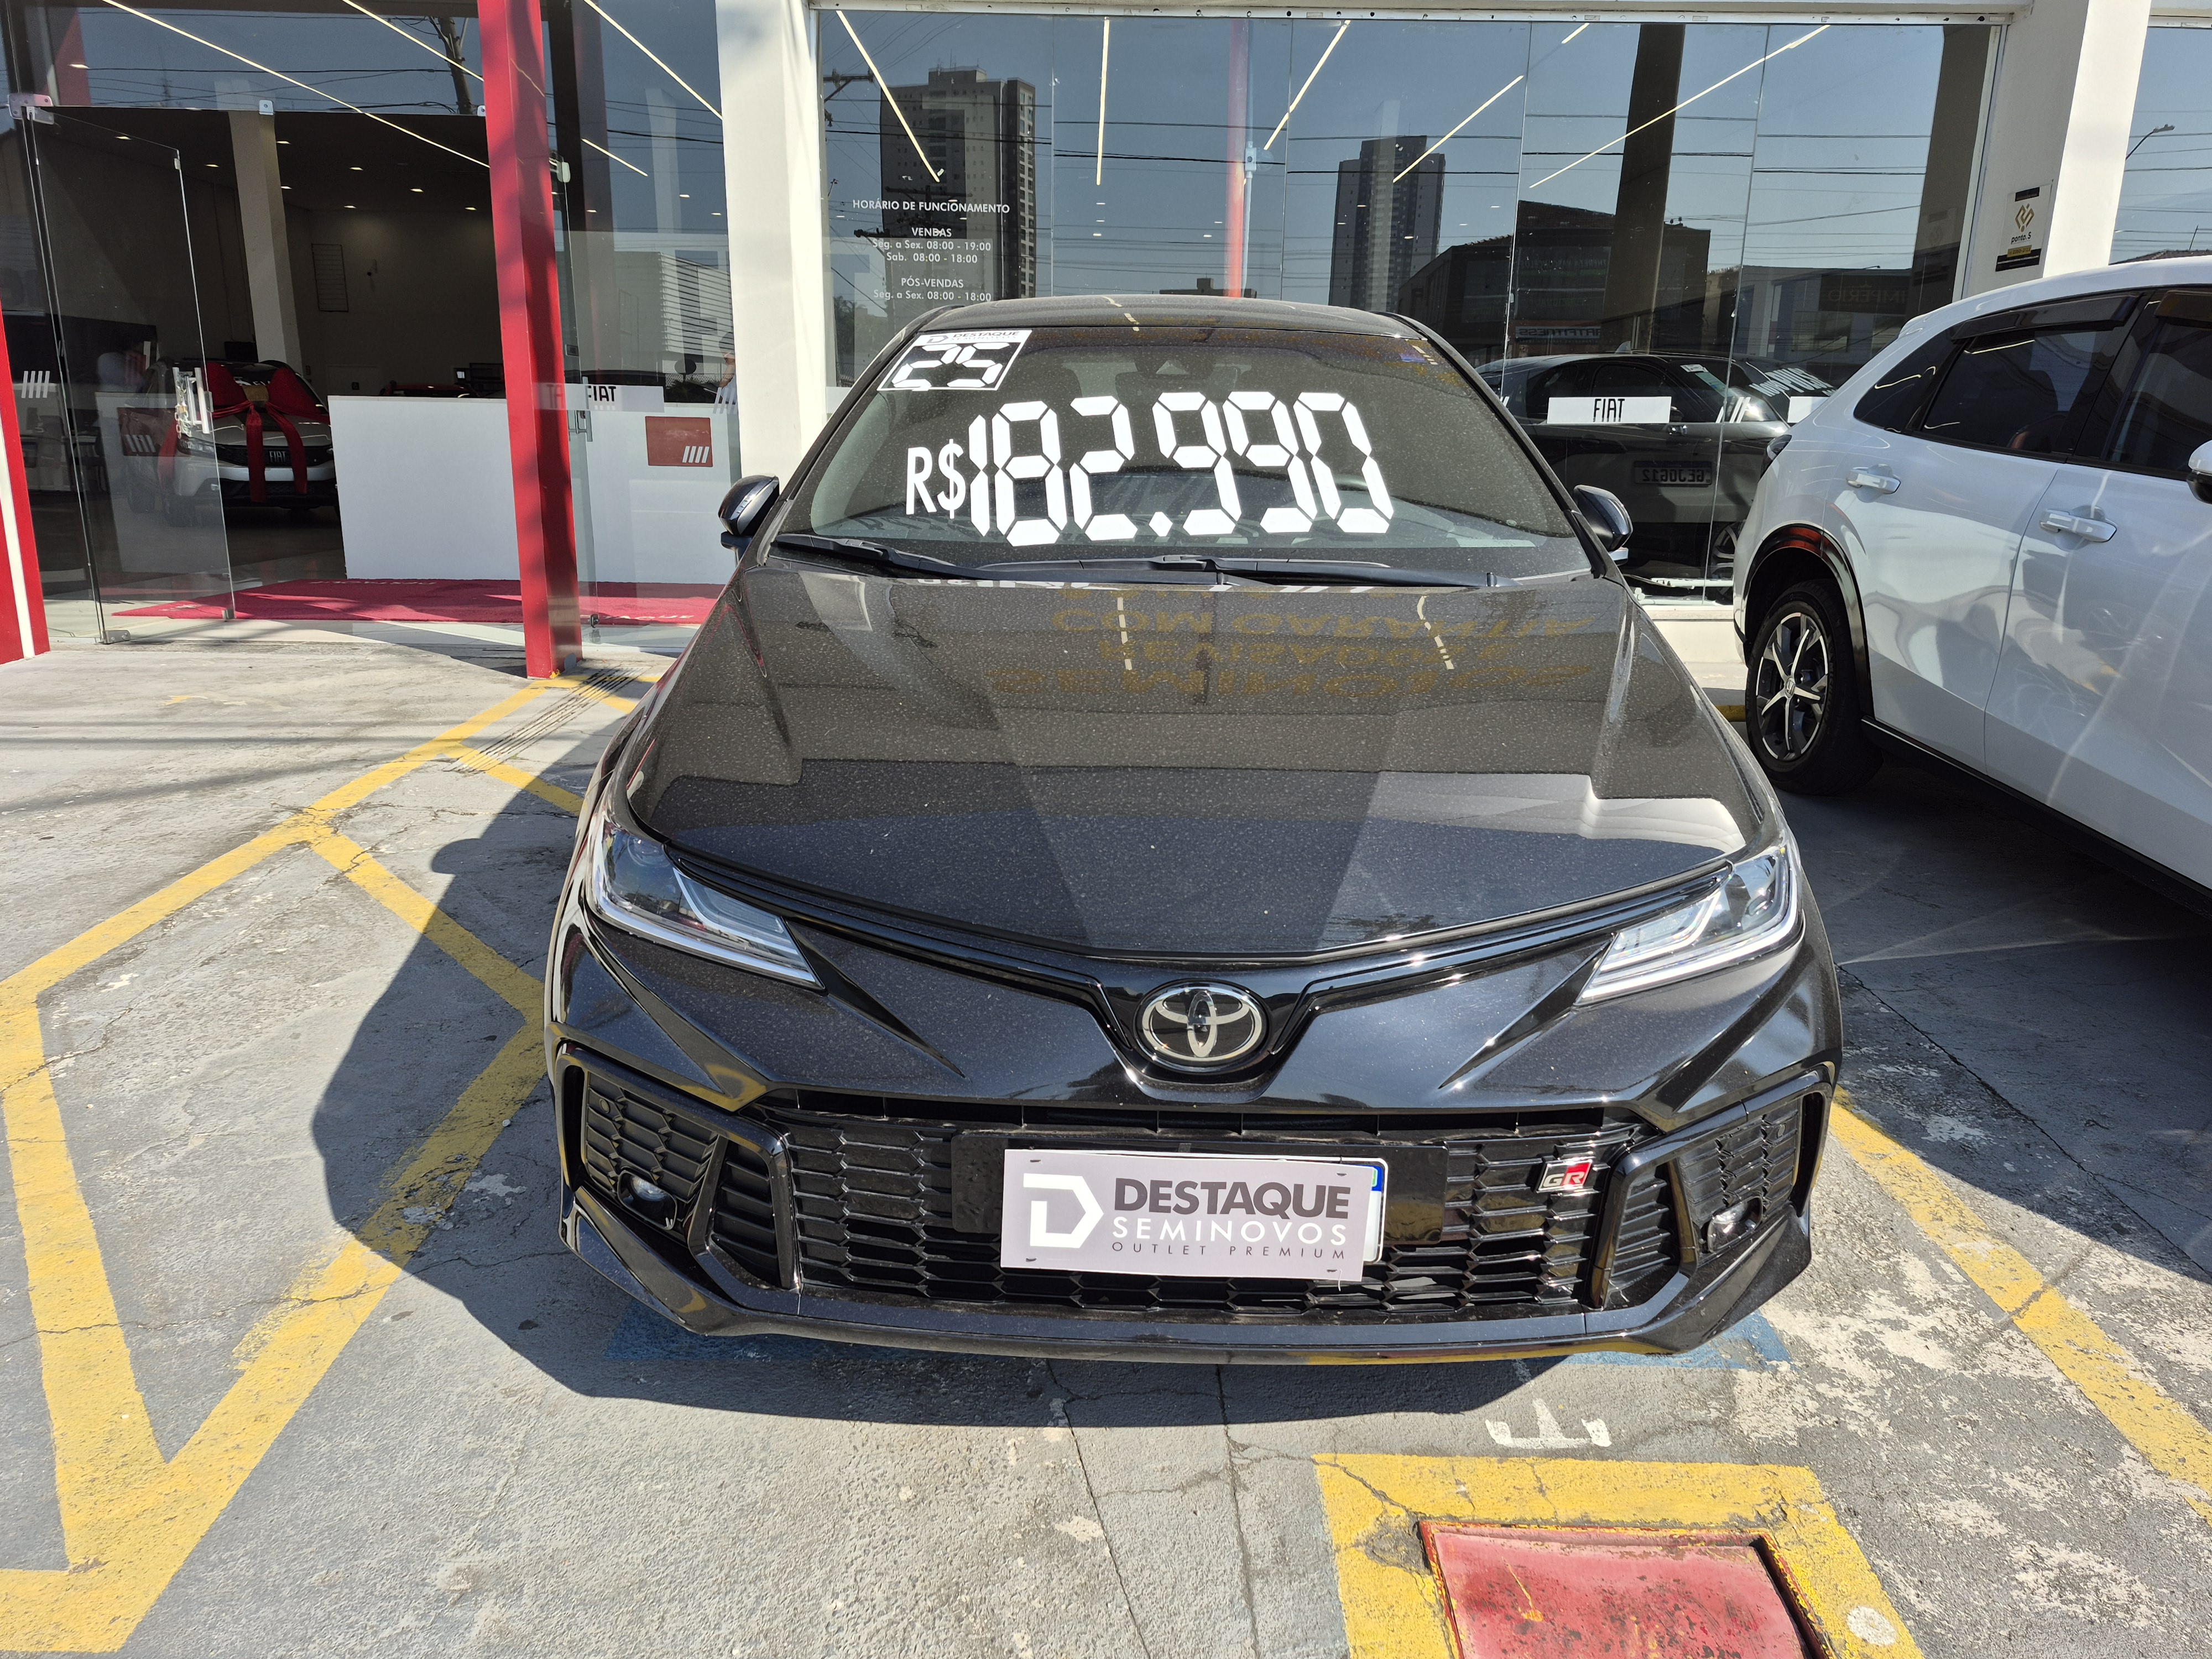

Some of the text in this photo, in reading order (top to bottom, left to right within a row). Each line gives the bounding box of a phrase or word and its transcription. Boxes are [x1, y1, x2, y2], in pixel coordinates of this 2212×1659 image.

[852, 197, 1010, 214] HORÁRIO DE FUNCIONAMENTO
[911, 227, 952, 238] VENDAS
[873, 239, 893, 251] Seg.
[904, 240, 924, 249] Sex.
[927, 241, 954, 251] 08:00
[964, 242, 992, 251] 19:00
[886, 252, 907, 262] Sab.
[912, 253, 941, 263] 08:00
[951, 254, 978, 264] 18:00
[901, 275, 964, 288] PÓS-VENDAS
[873, 289, 894, 300] Seg.
[904, 290, 925, 300] Sex.
[927, 291, 954, 301] 08:00
[964, 293, 992, 302] 18:00
[891, 342, 1010, 388] 25
[1748, 368, 1834, 397] Novo PULSE
[1593, 398, 1625, 423] FIAT
[269, 450, 286, 463] FIAT
[1543, 1171, 1585, 1187] GR
[1114, 1177, 1351, 1219] DESTAQUE
[1112, 1216, 1347, 1246] SEMINOVOS
[1112, 1241, 1345, 1260] OUTLET PREMIUM
